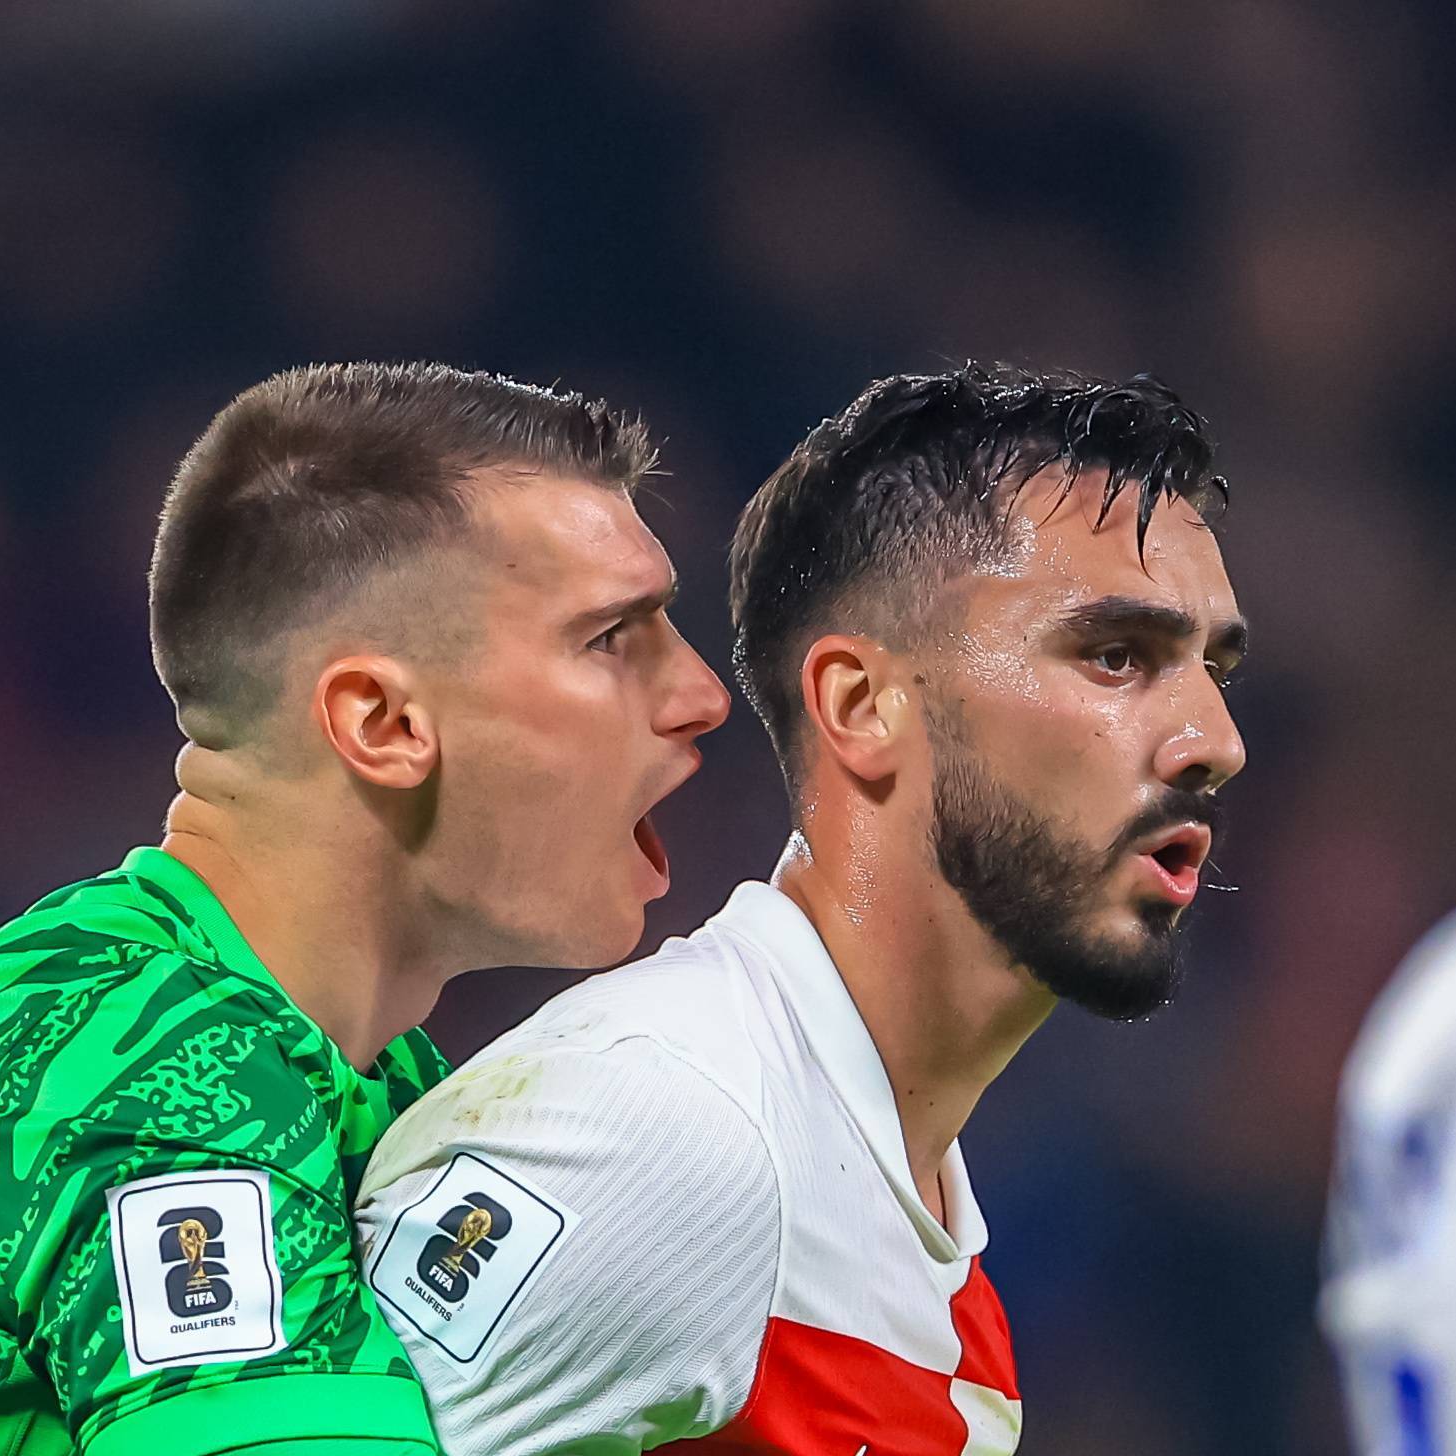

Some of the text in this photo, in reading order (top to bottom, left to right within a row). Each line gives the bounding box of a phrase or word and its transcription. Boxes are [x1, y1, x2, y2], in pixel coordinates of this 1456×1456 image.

[428, 1264, 454, 1292] FIFA
[184, 1291, 217, 1308] FIFA
[404, 1276, 452, 1322] QUALIFIERS
[170, 1316, 236, 1334] QUALIFIERS
